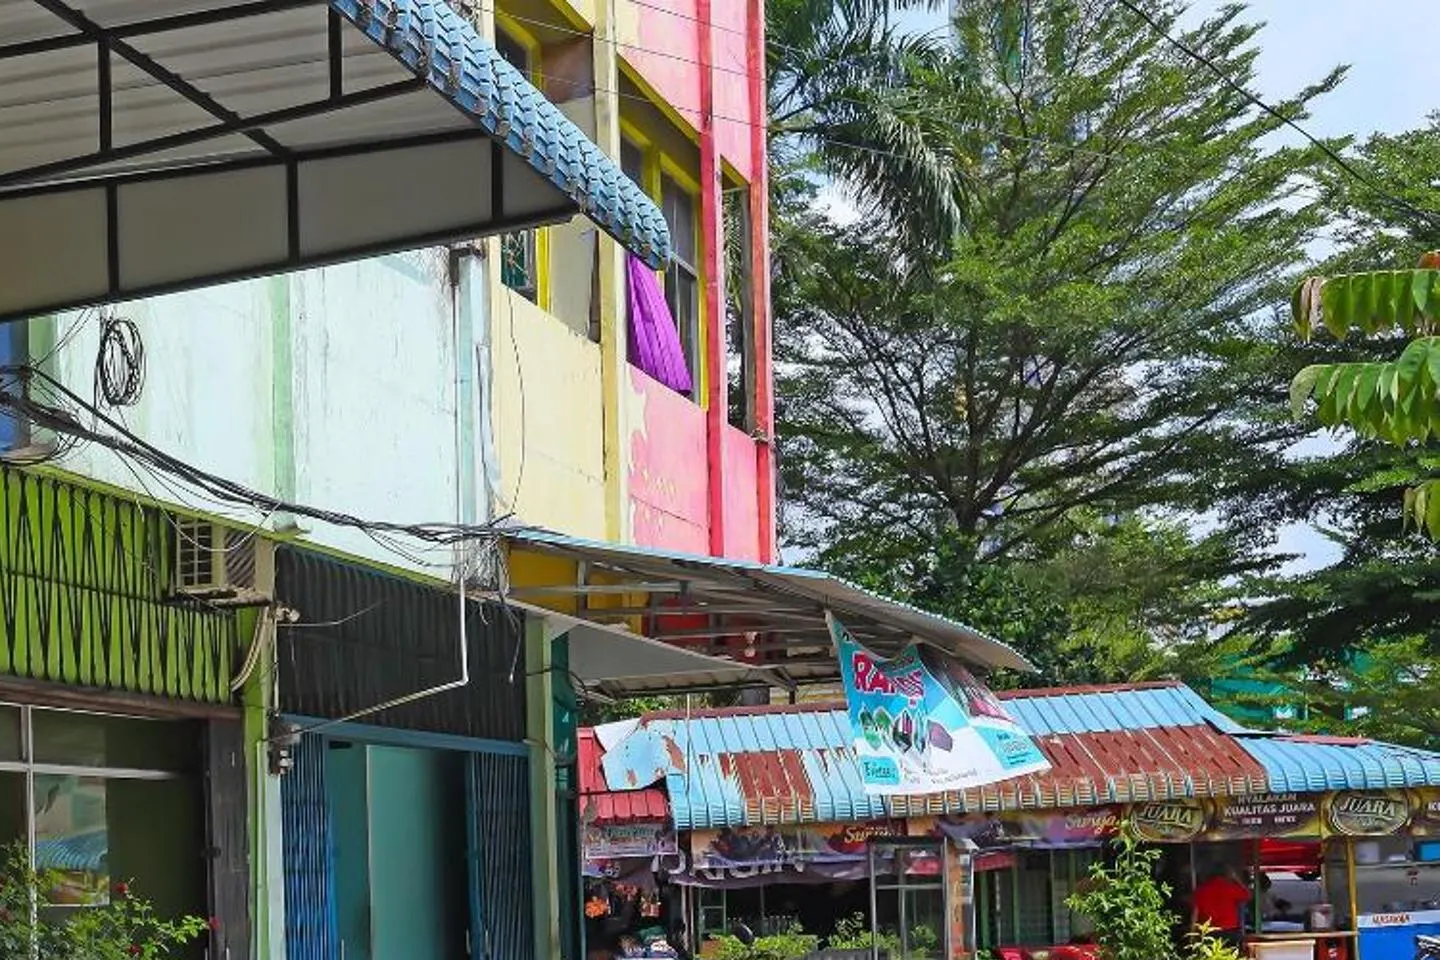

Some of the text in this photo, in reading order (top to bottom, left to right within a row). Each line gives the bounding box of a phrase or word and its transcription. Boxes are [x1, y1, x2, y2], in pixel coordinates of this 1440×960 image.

[1224, 802, 1316, 817] KUALITAS JUARA
[1340, 797, 1396, 818] JUARA
